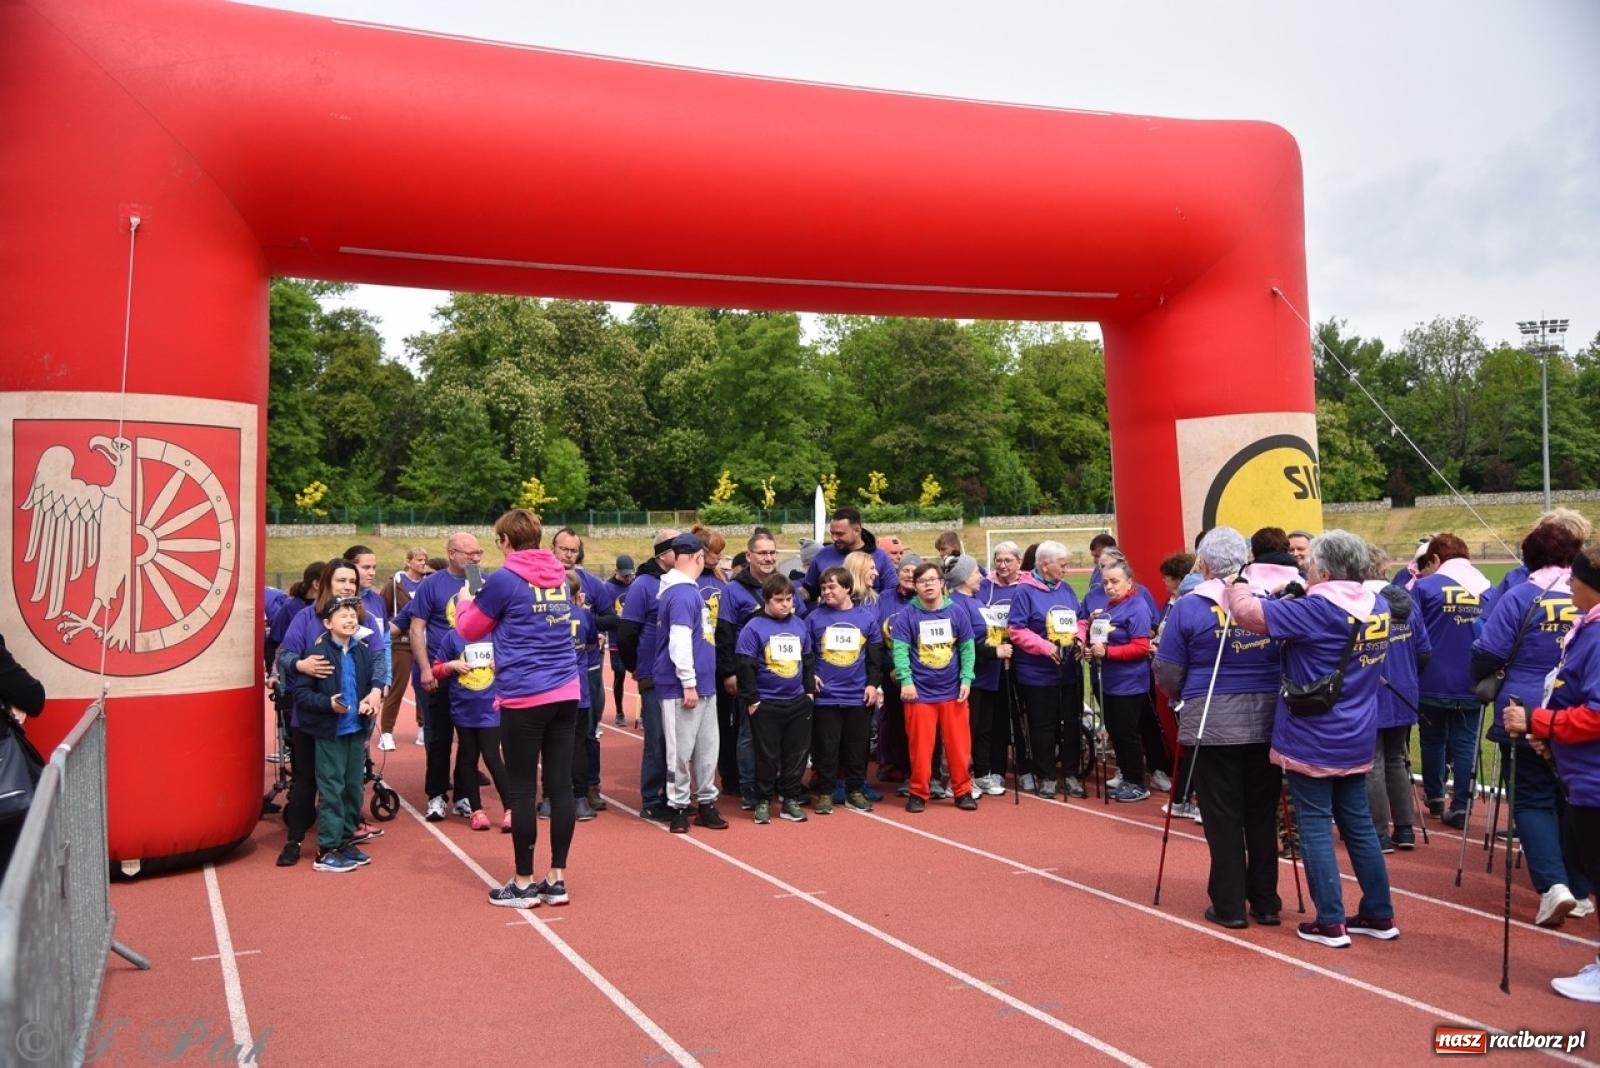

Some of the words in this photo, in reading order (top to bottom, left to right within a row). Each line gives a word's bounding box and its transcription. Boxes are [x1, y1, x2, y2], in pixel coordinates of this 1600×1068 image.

[930, 628, 945, 636] 118
[835, 635, 851, 644] 154
[778, 644, 793, 653] 158
[474, 651, 491, 659] 166
